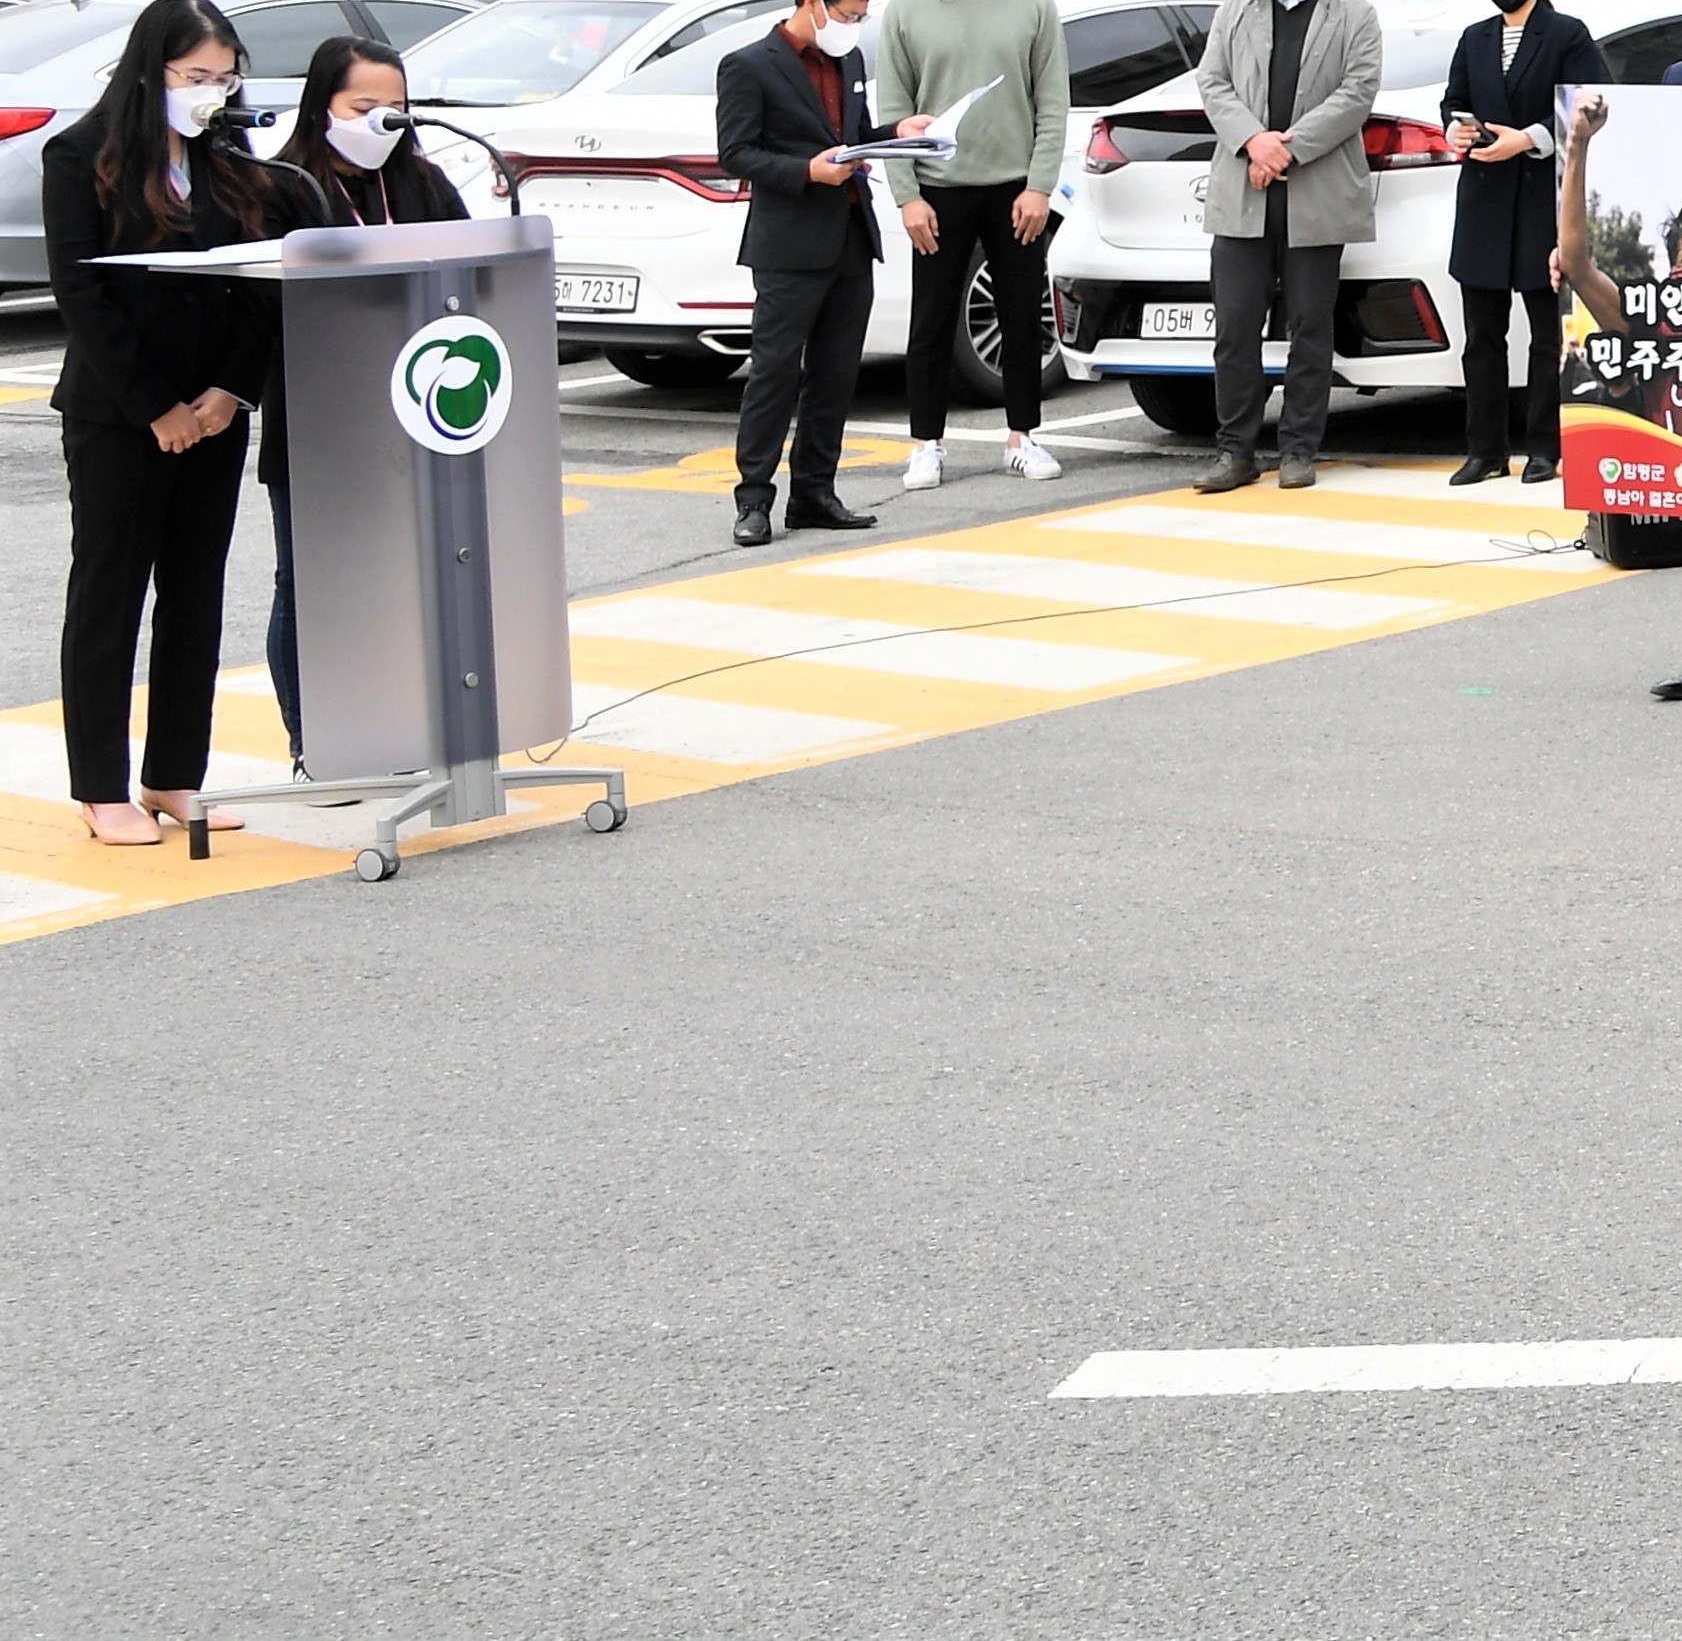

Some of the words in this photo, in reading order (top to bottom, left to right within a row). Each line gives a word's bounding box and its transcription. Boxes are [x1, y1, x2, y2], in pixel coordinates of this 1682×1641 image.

[582, 280, 624, 304] 7231
[1623, 461, 1665, 483] 함평군
[1603, 487, 1645, 507] 동남아
